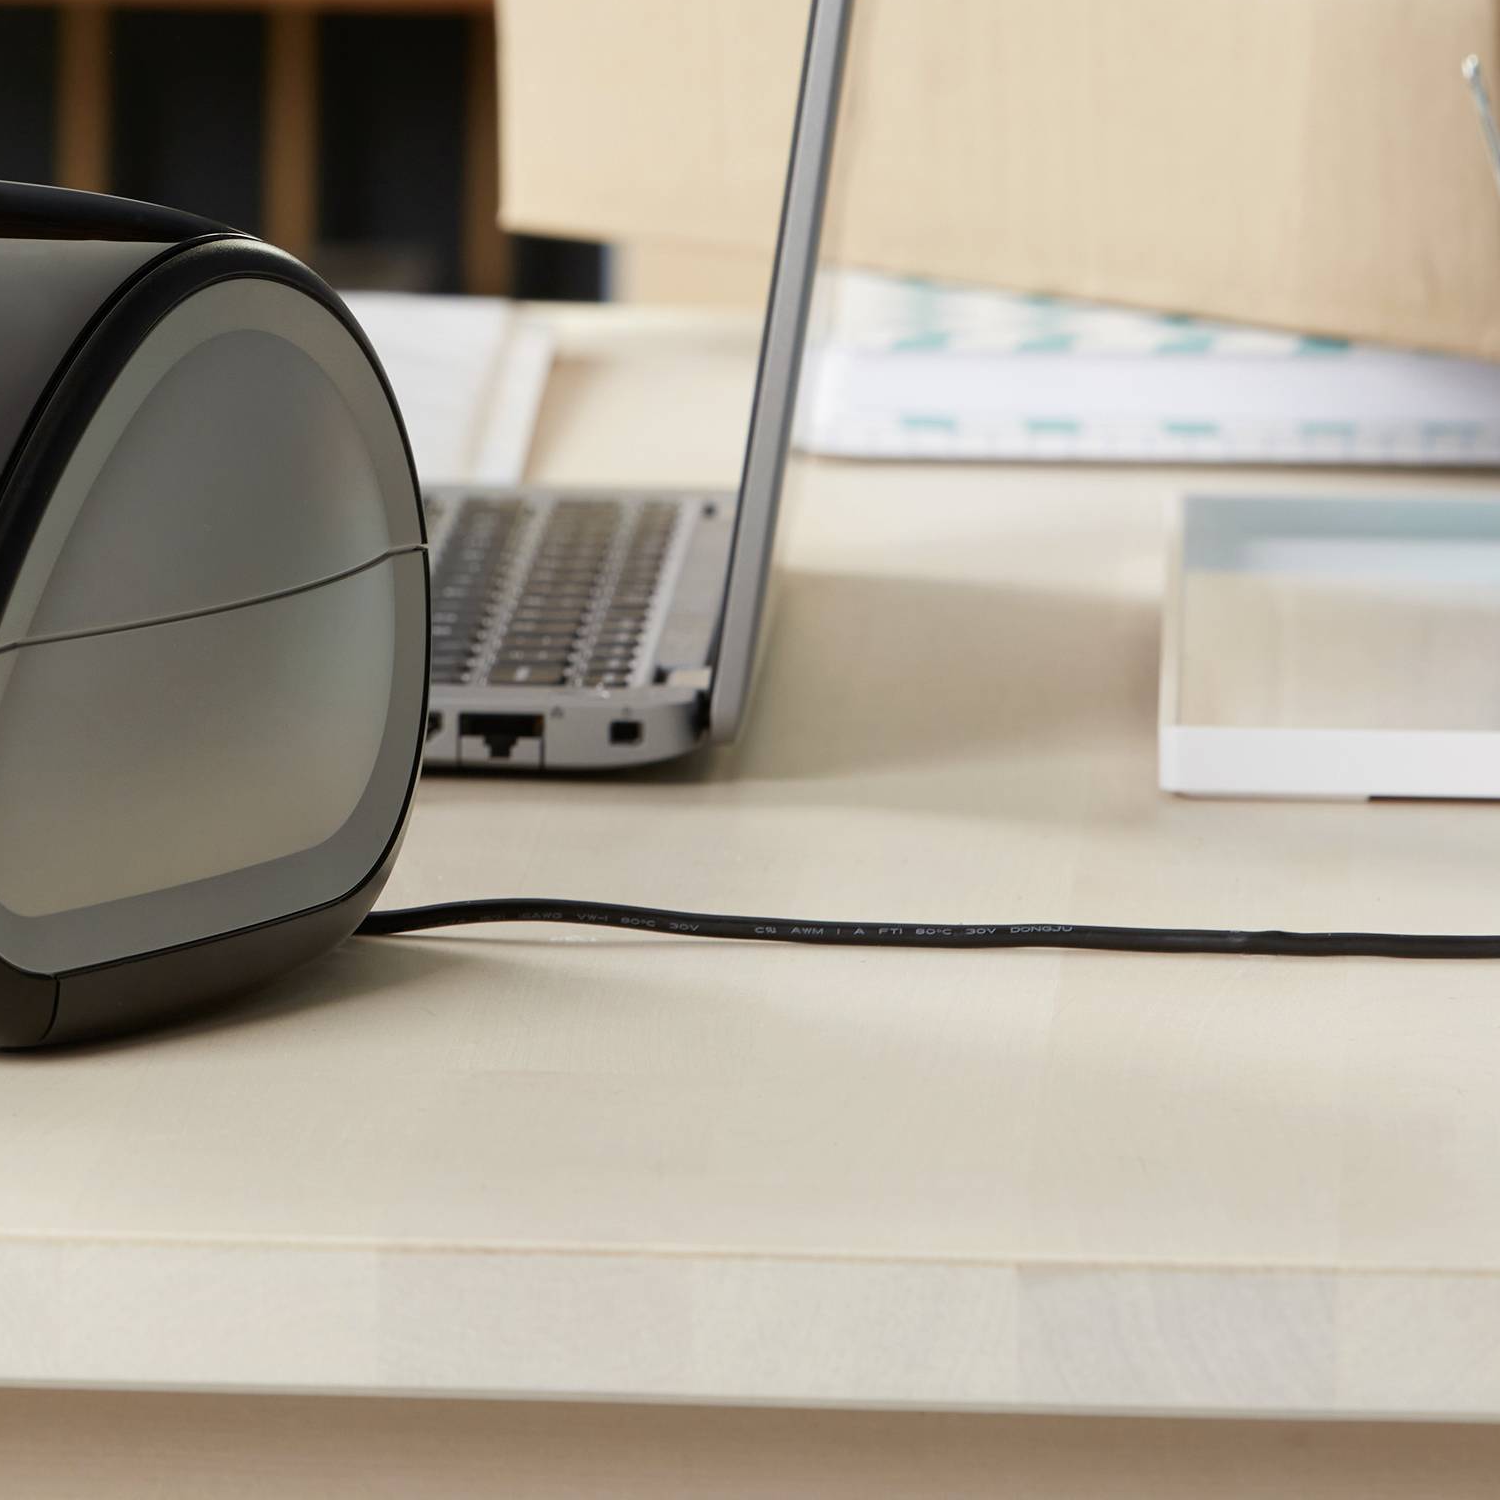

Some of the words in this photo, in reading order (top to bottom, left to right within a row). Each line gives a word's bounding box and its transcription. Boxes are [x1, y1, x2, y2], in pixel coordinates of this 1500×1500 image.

[790, 926, 825, 935] AWM
[852, 927, 866, 936] A
[965, 927, 997, 936] 30V
[1010, 925, 1074, 934] DONGJU
